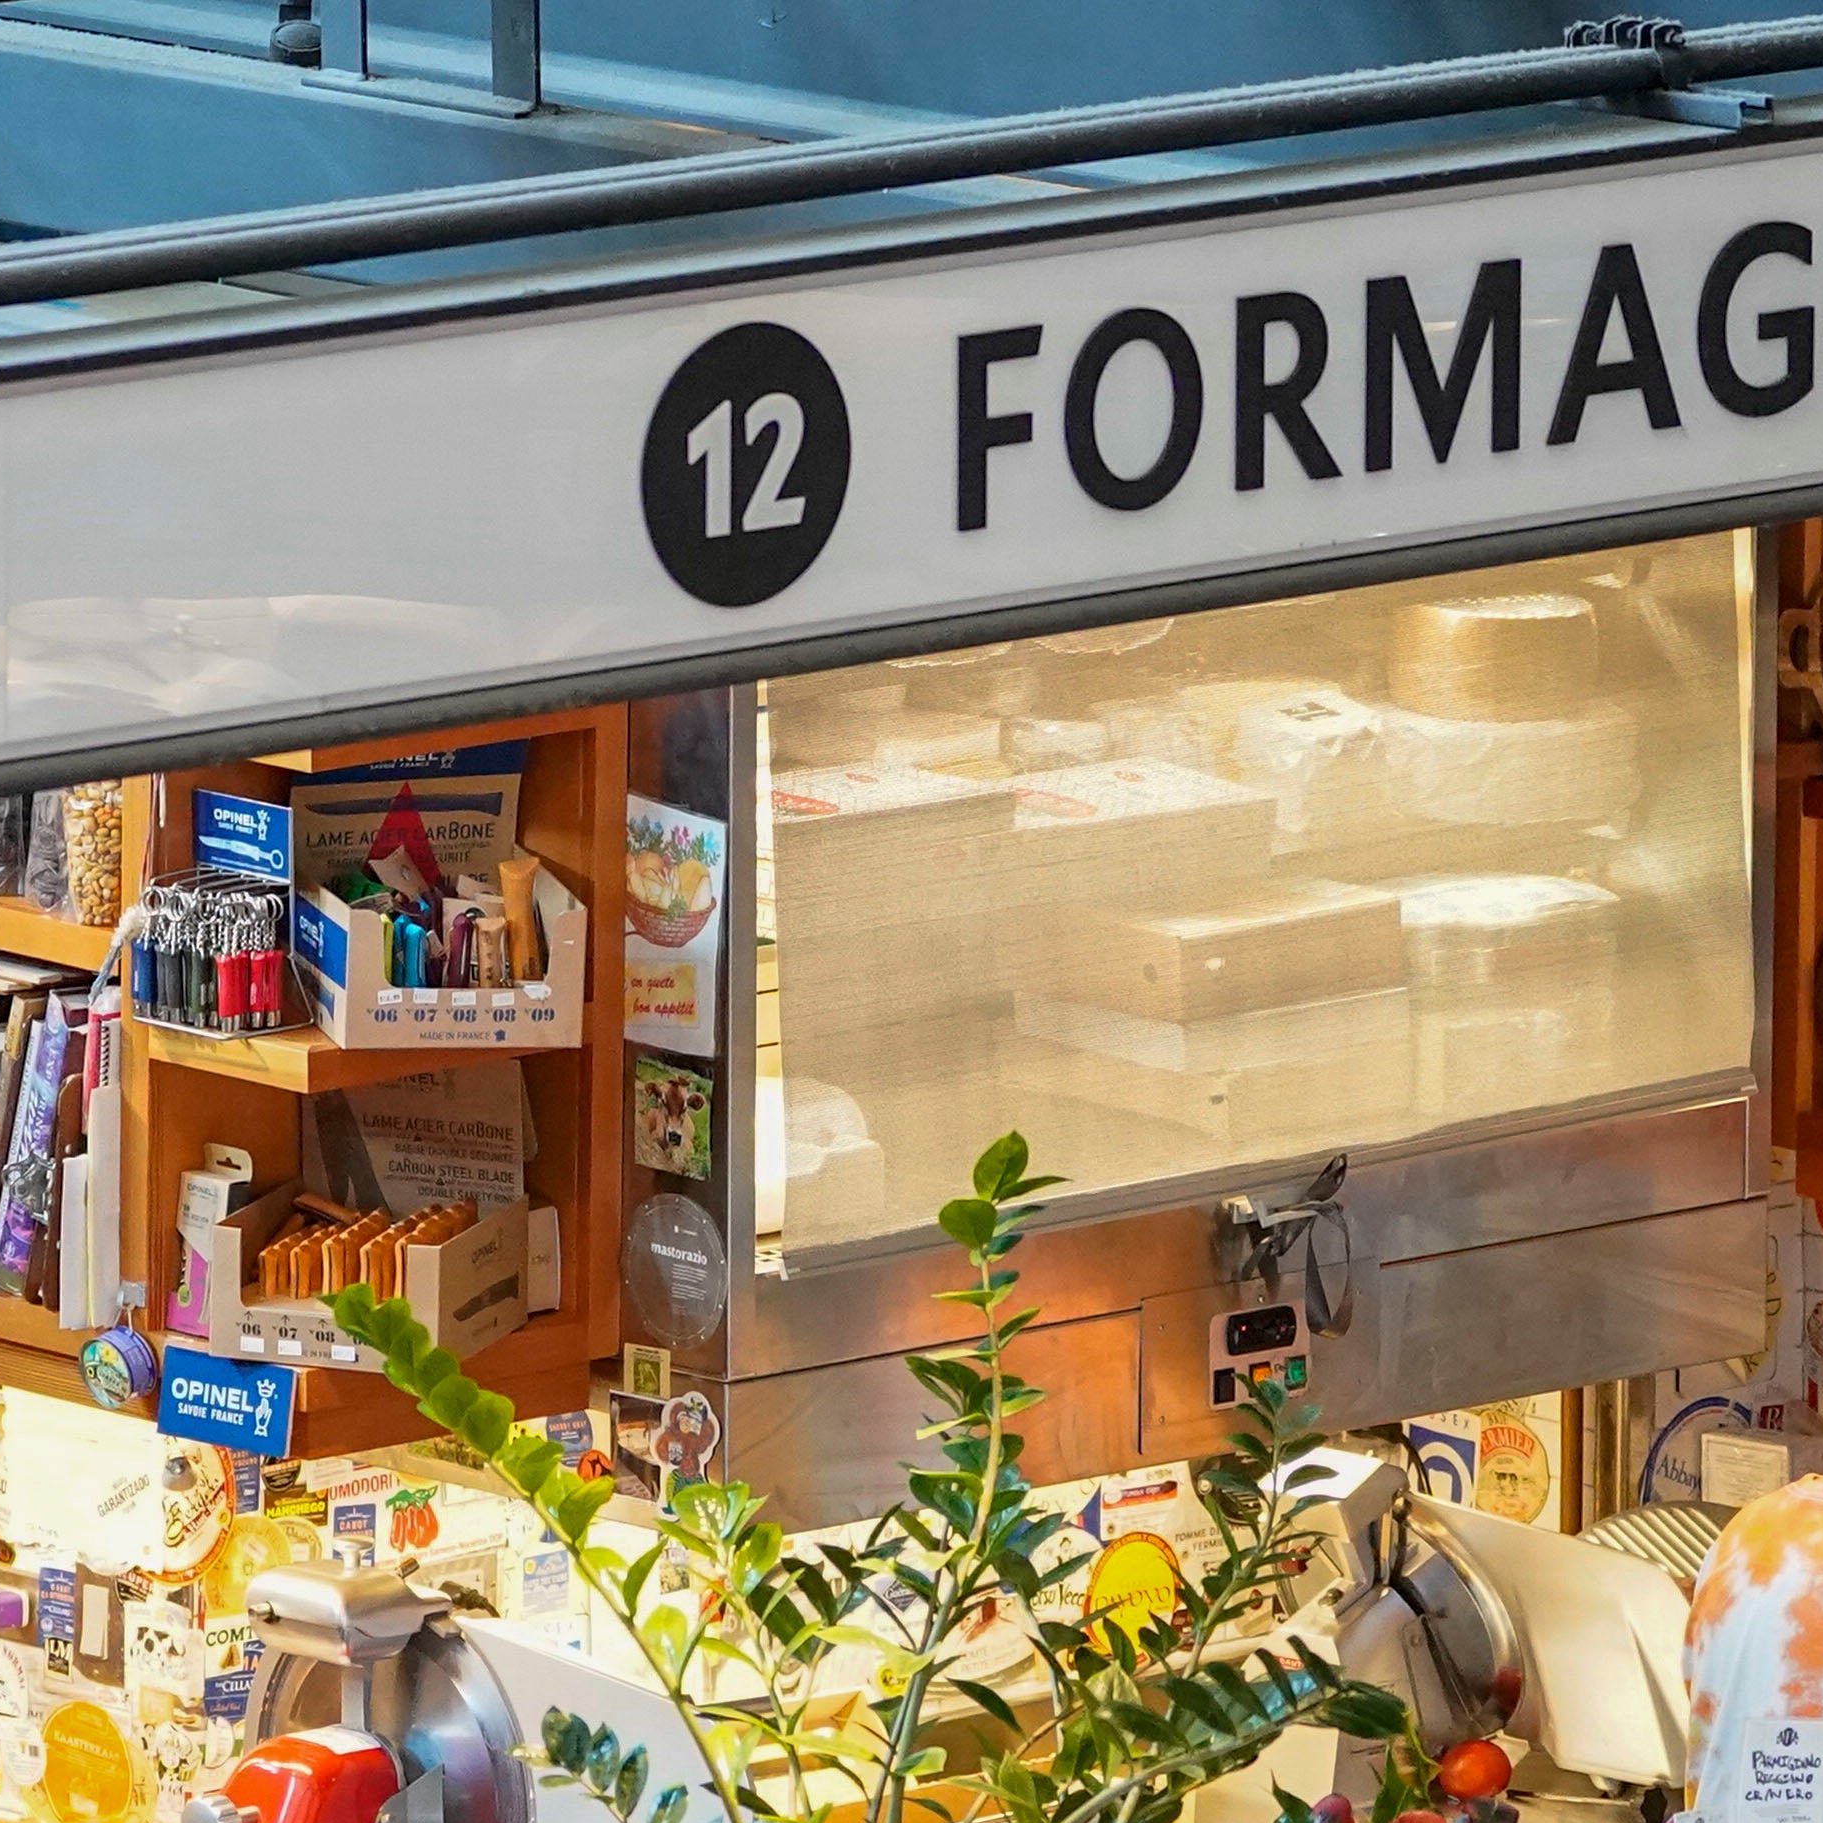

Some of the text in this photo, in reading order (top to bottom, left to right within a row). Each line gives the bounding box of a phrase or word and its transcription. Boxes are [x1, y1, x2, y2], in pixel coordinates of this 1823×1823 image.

[684, 386, 811, 538] 12
[213, 806, 258, 829] OPINEL
[305, 829, 355, 848] LAME
[412, 821, 495, 842] CARBONE
[297, 914, 322, 941] OPINEL
[458, 1030, 490, 1041] FRANCE
[362, 1114, 514, 1142] LAME ACIER CARBONE
[388, 1160, 514, 1184] CARBON STEEL BLADE
[650, 1241, 708, 1267] mastorazio
[171, 1376, 254, 1414] OPINEL
[177, 1402, 244, 1427] SAVOIE FRANCE
[96, 1473, 151, 1518] GARANTIZADO
[327, 1473, 393, 1501] OMODORI
[266, 1500, 326, 1519] MANCHEGO
[339, 1519, 368, 1532] CABOT
[1057, 1583, 1085, 1612] Vecc
[47, 1636, 73, 1660] LM
[205, 1626, 254, 1647] COMT
